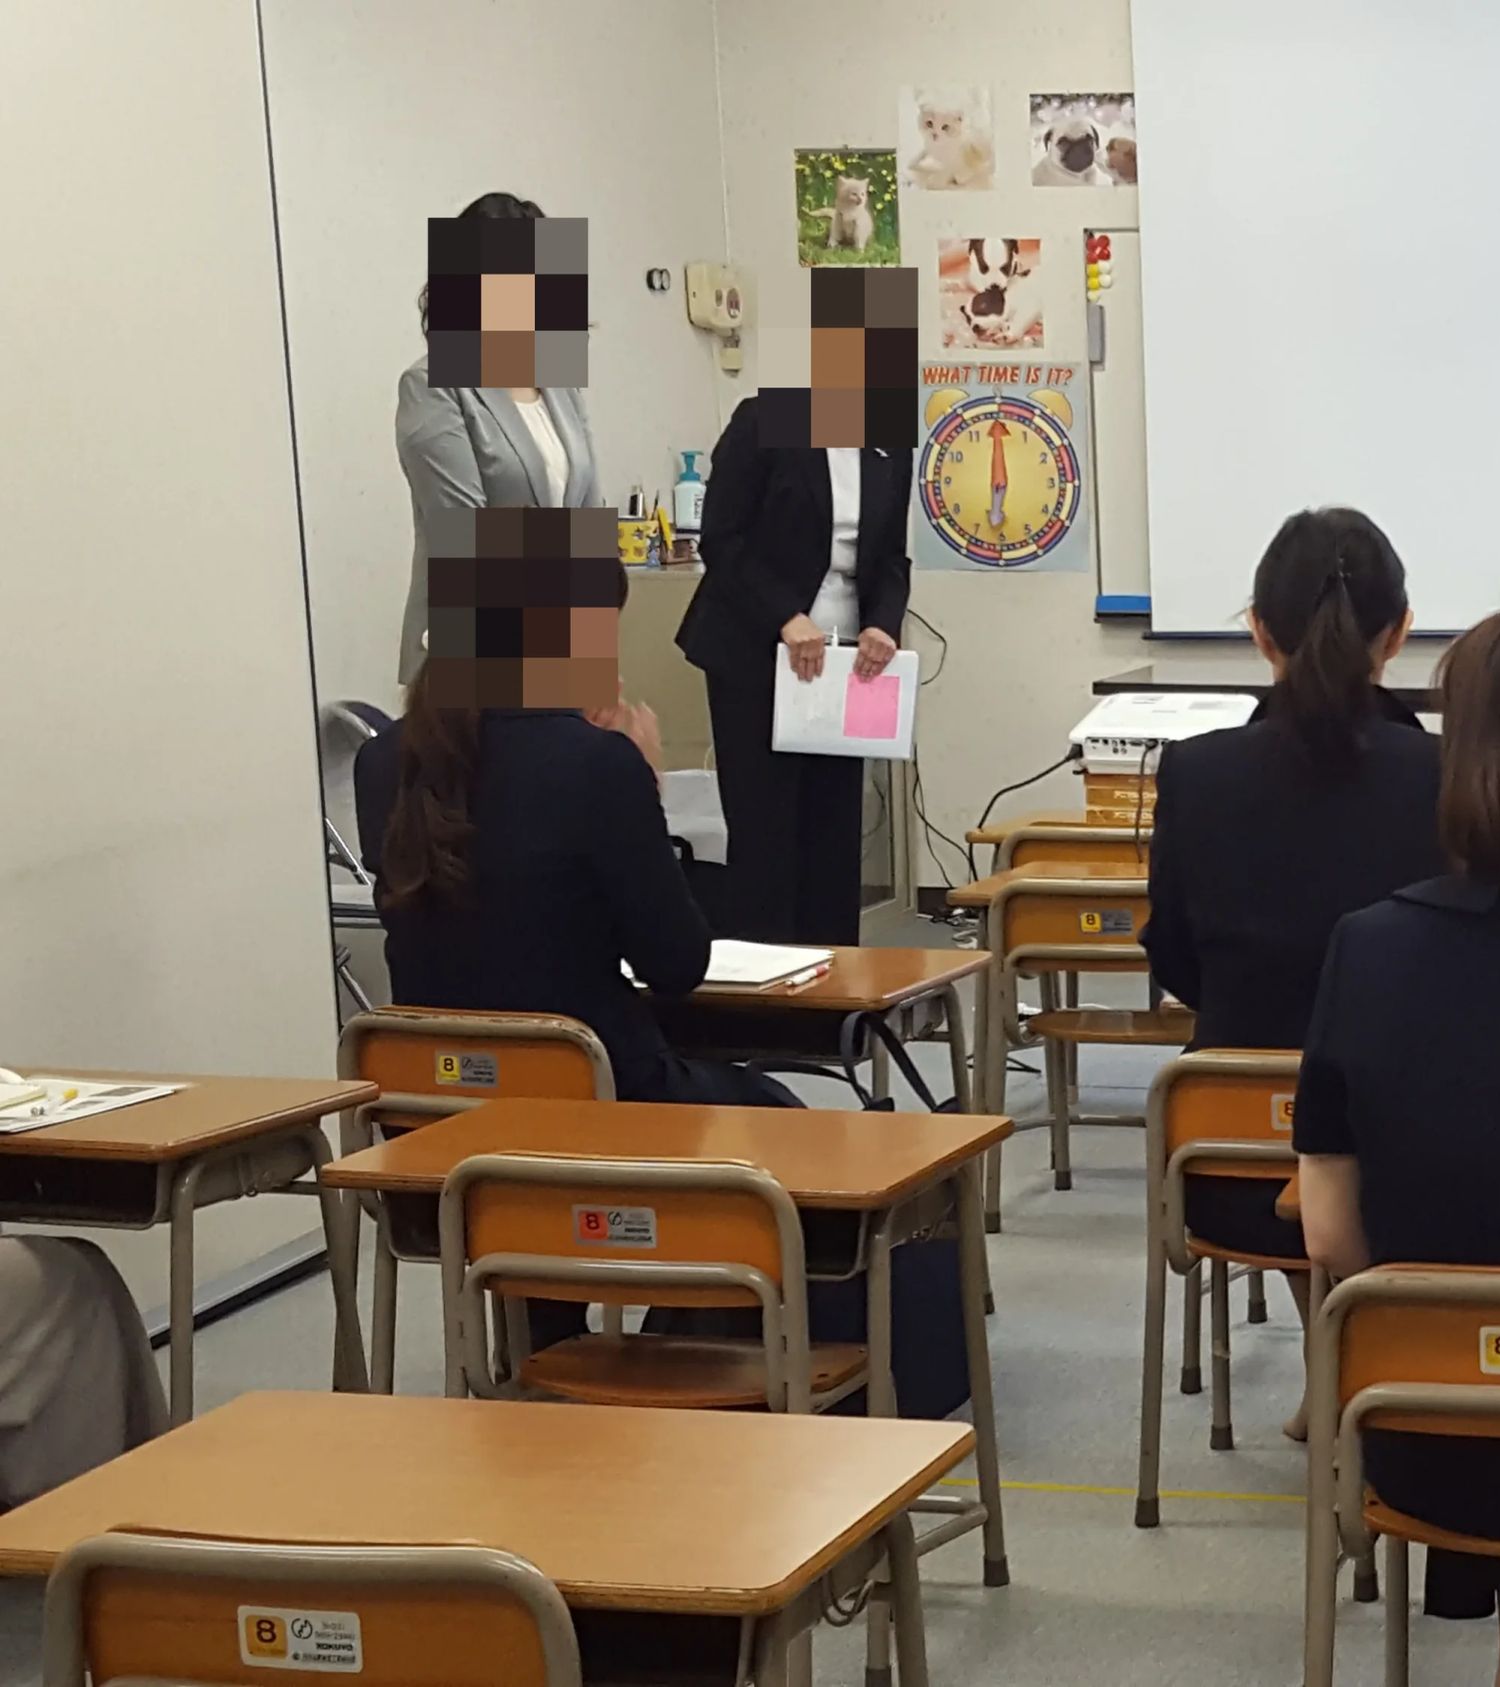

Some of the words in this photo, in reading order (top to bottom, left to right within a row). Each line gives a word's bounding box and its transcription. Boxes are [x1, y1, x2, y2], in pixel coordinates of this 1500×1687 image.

[923, 366, 971, 385] WHAT
[978, 365, 1020, 384] TIME
[1025, 366, 1042, 384] IS
[1046, 367, 1073, 385] IT?
[969, 430, 980, 442] 11
[950, 451, 963, 463] 10
[1039, 452, 1048, 464] 2
[944, 476, 952, 487] 9
[1047, 477, 1056, 489] 3
[973, 523, 981, 535] 7
[1024, 523, 1032, 535] 5
[444, 1057, 454, 1072] 8
[586, 1213, 599, 1230] 8
[256, 1619, 277, 1643] 8
